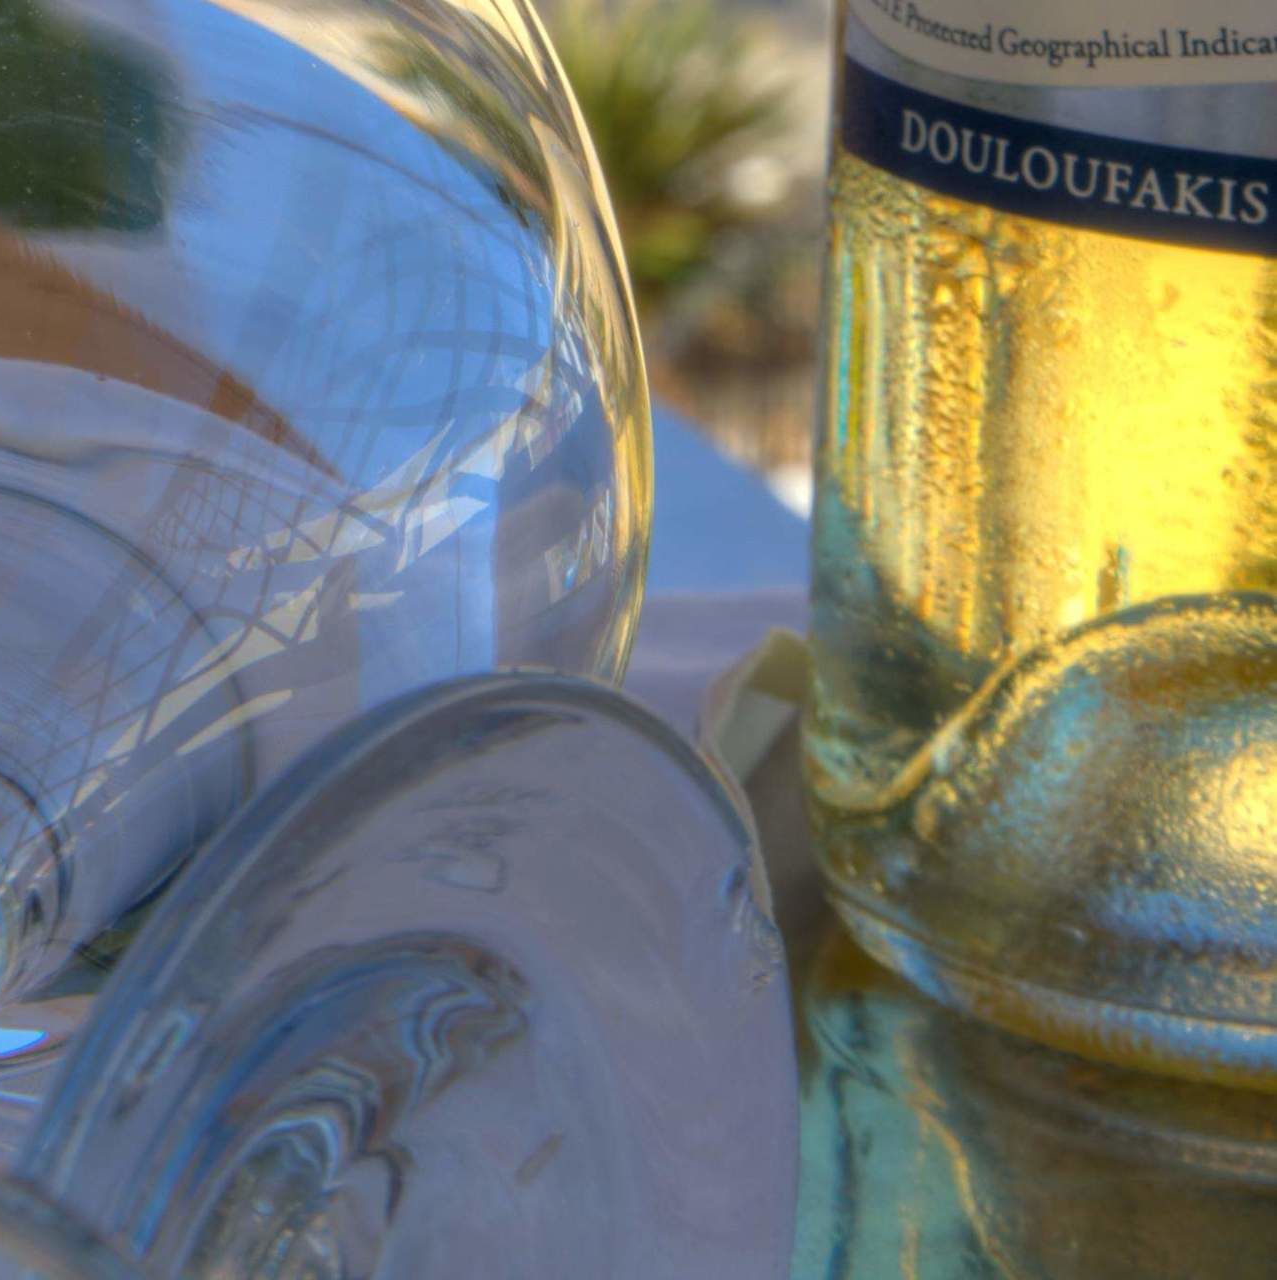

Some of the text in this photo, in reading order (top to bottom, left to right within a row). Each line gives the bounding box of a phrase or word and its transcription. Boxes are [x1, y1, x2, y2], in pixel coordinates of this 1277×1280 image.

[905, 1, 994, 54] Protected
[998, 27, 1171, 68] Geographical
[1178, 26, 1277, 58] Indica
[900, 109, 1269, 225] DOULOUFAKIS
